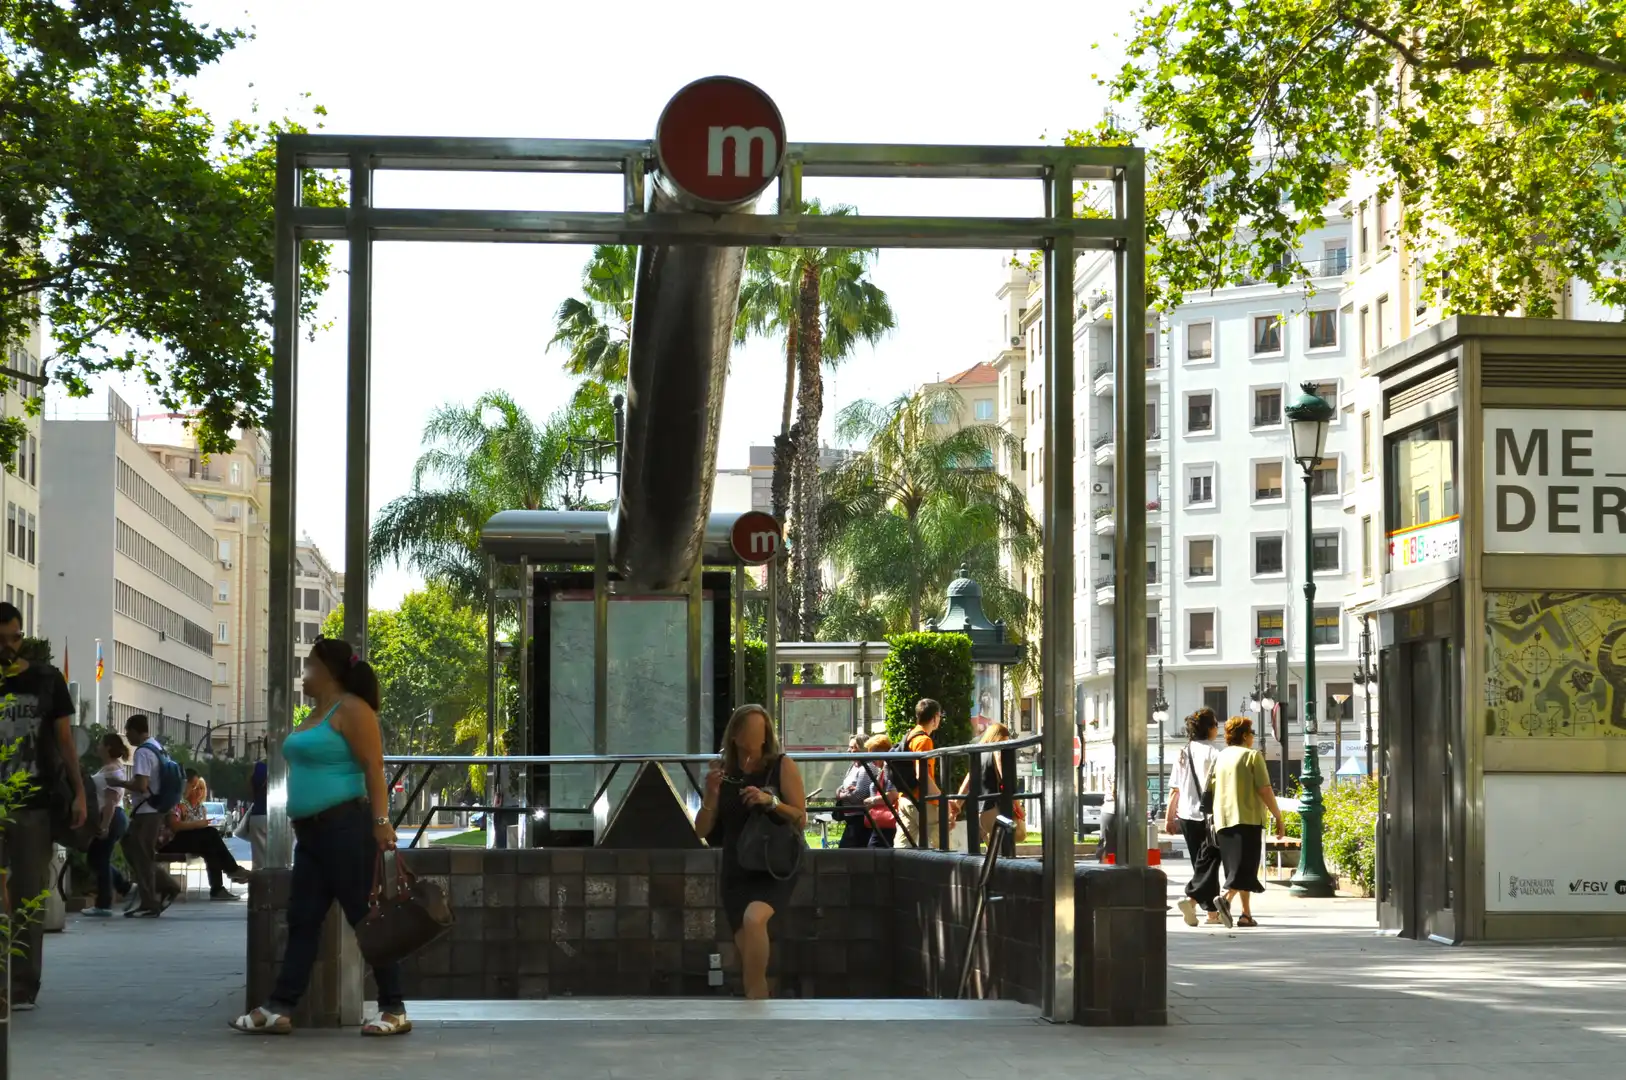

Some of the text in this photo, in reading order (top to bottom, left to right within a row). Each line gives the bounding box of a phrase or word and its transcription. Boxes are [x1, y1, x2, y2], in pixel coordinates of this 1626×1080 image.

[707, 125, 777, 178] m
[1496, 484, 1626, 534] DER
[750, 531, 780, 553] m
[1583, 881, 1609, 892] FGV
